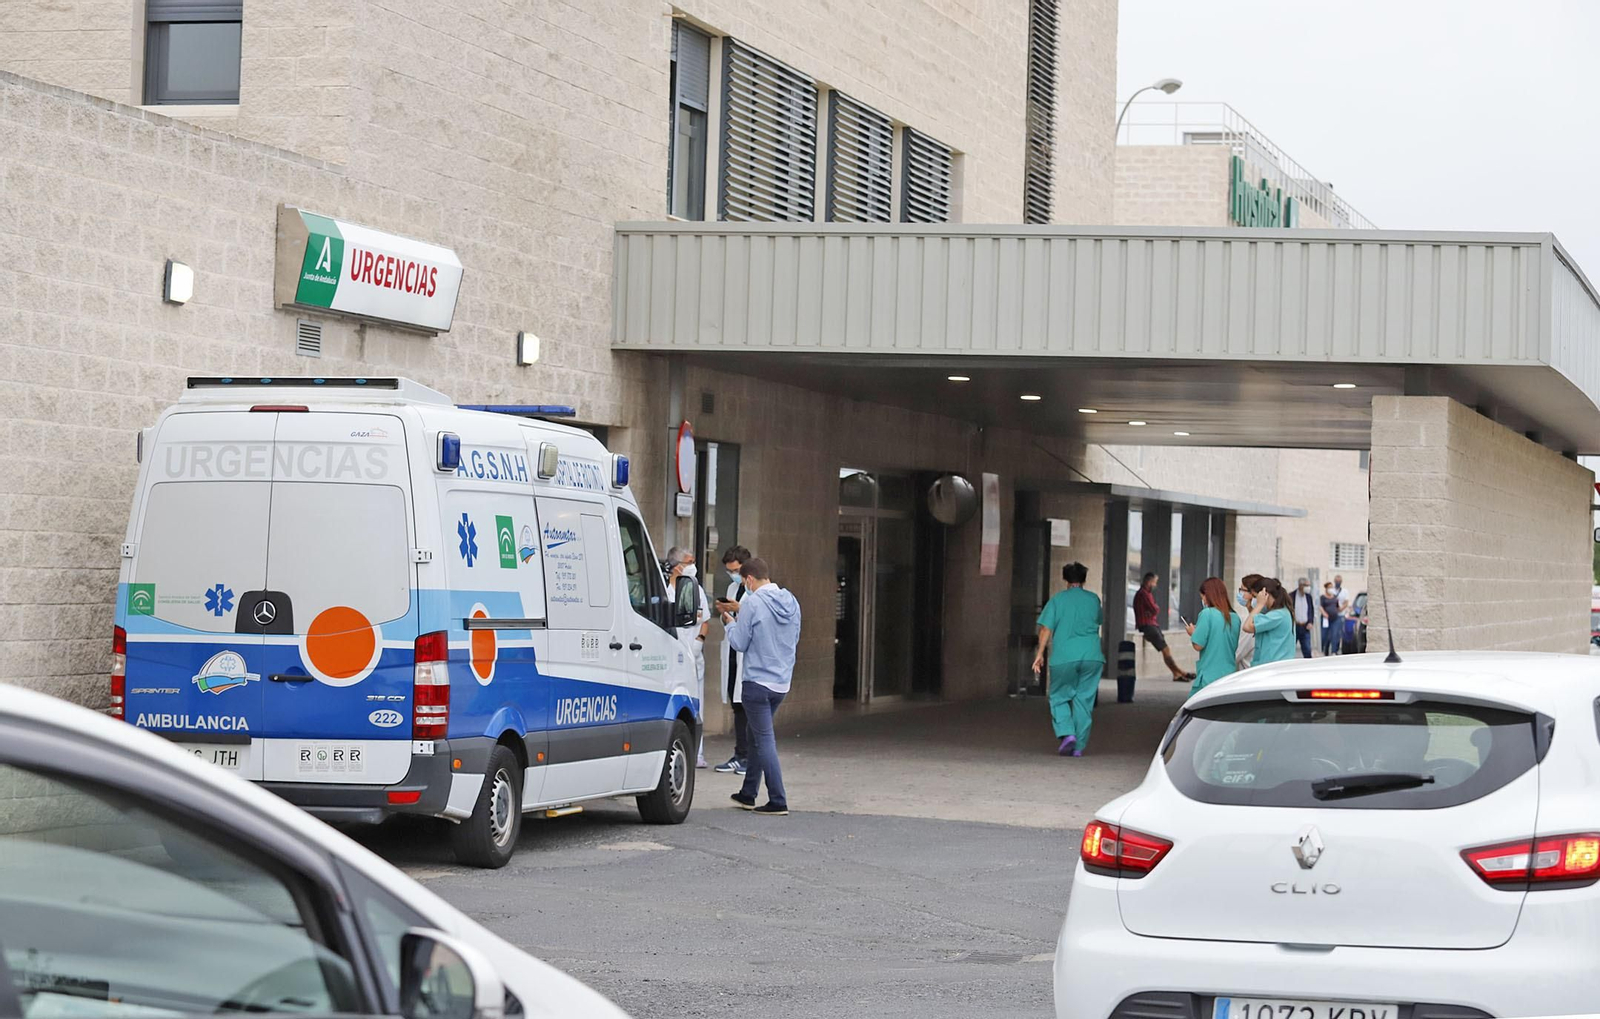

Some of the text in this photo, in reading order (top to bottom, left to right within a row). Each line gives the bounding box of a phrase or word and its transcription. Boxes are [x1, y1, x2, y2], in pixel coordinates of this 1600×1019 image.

[303, 272, 315, 281] Junta
[350, 248, 438, 298] URGENCIAS
[164, 444, 389, 480] URGENCIAS
[374, 712, 398, 724] 222
[556, 694, 618, 726] URGENCIAS
[135, 712, 250, 731] AMBULANCIA
[1270, 882, 1342, 895] CLIO
